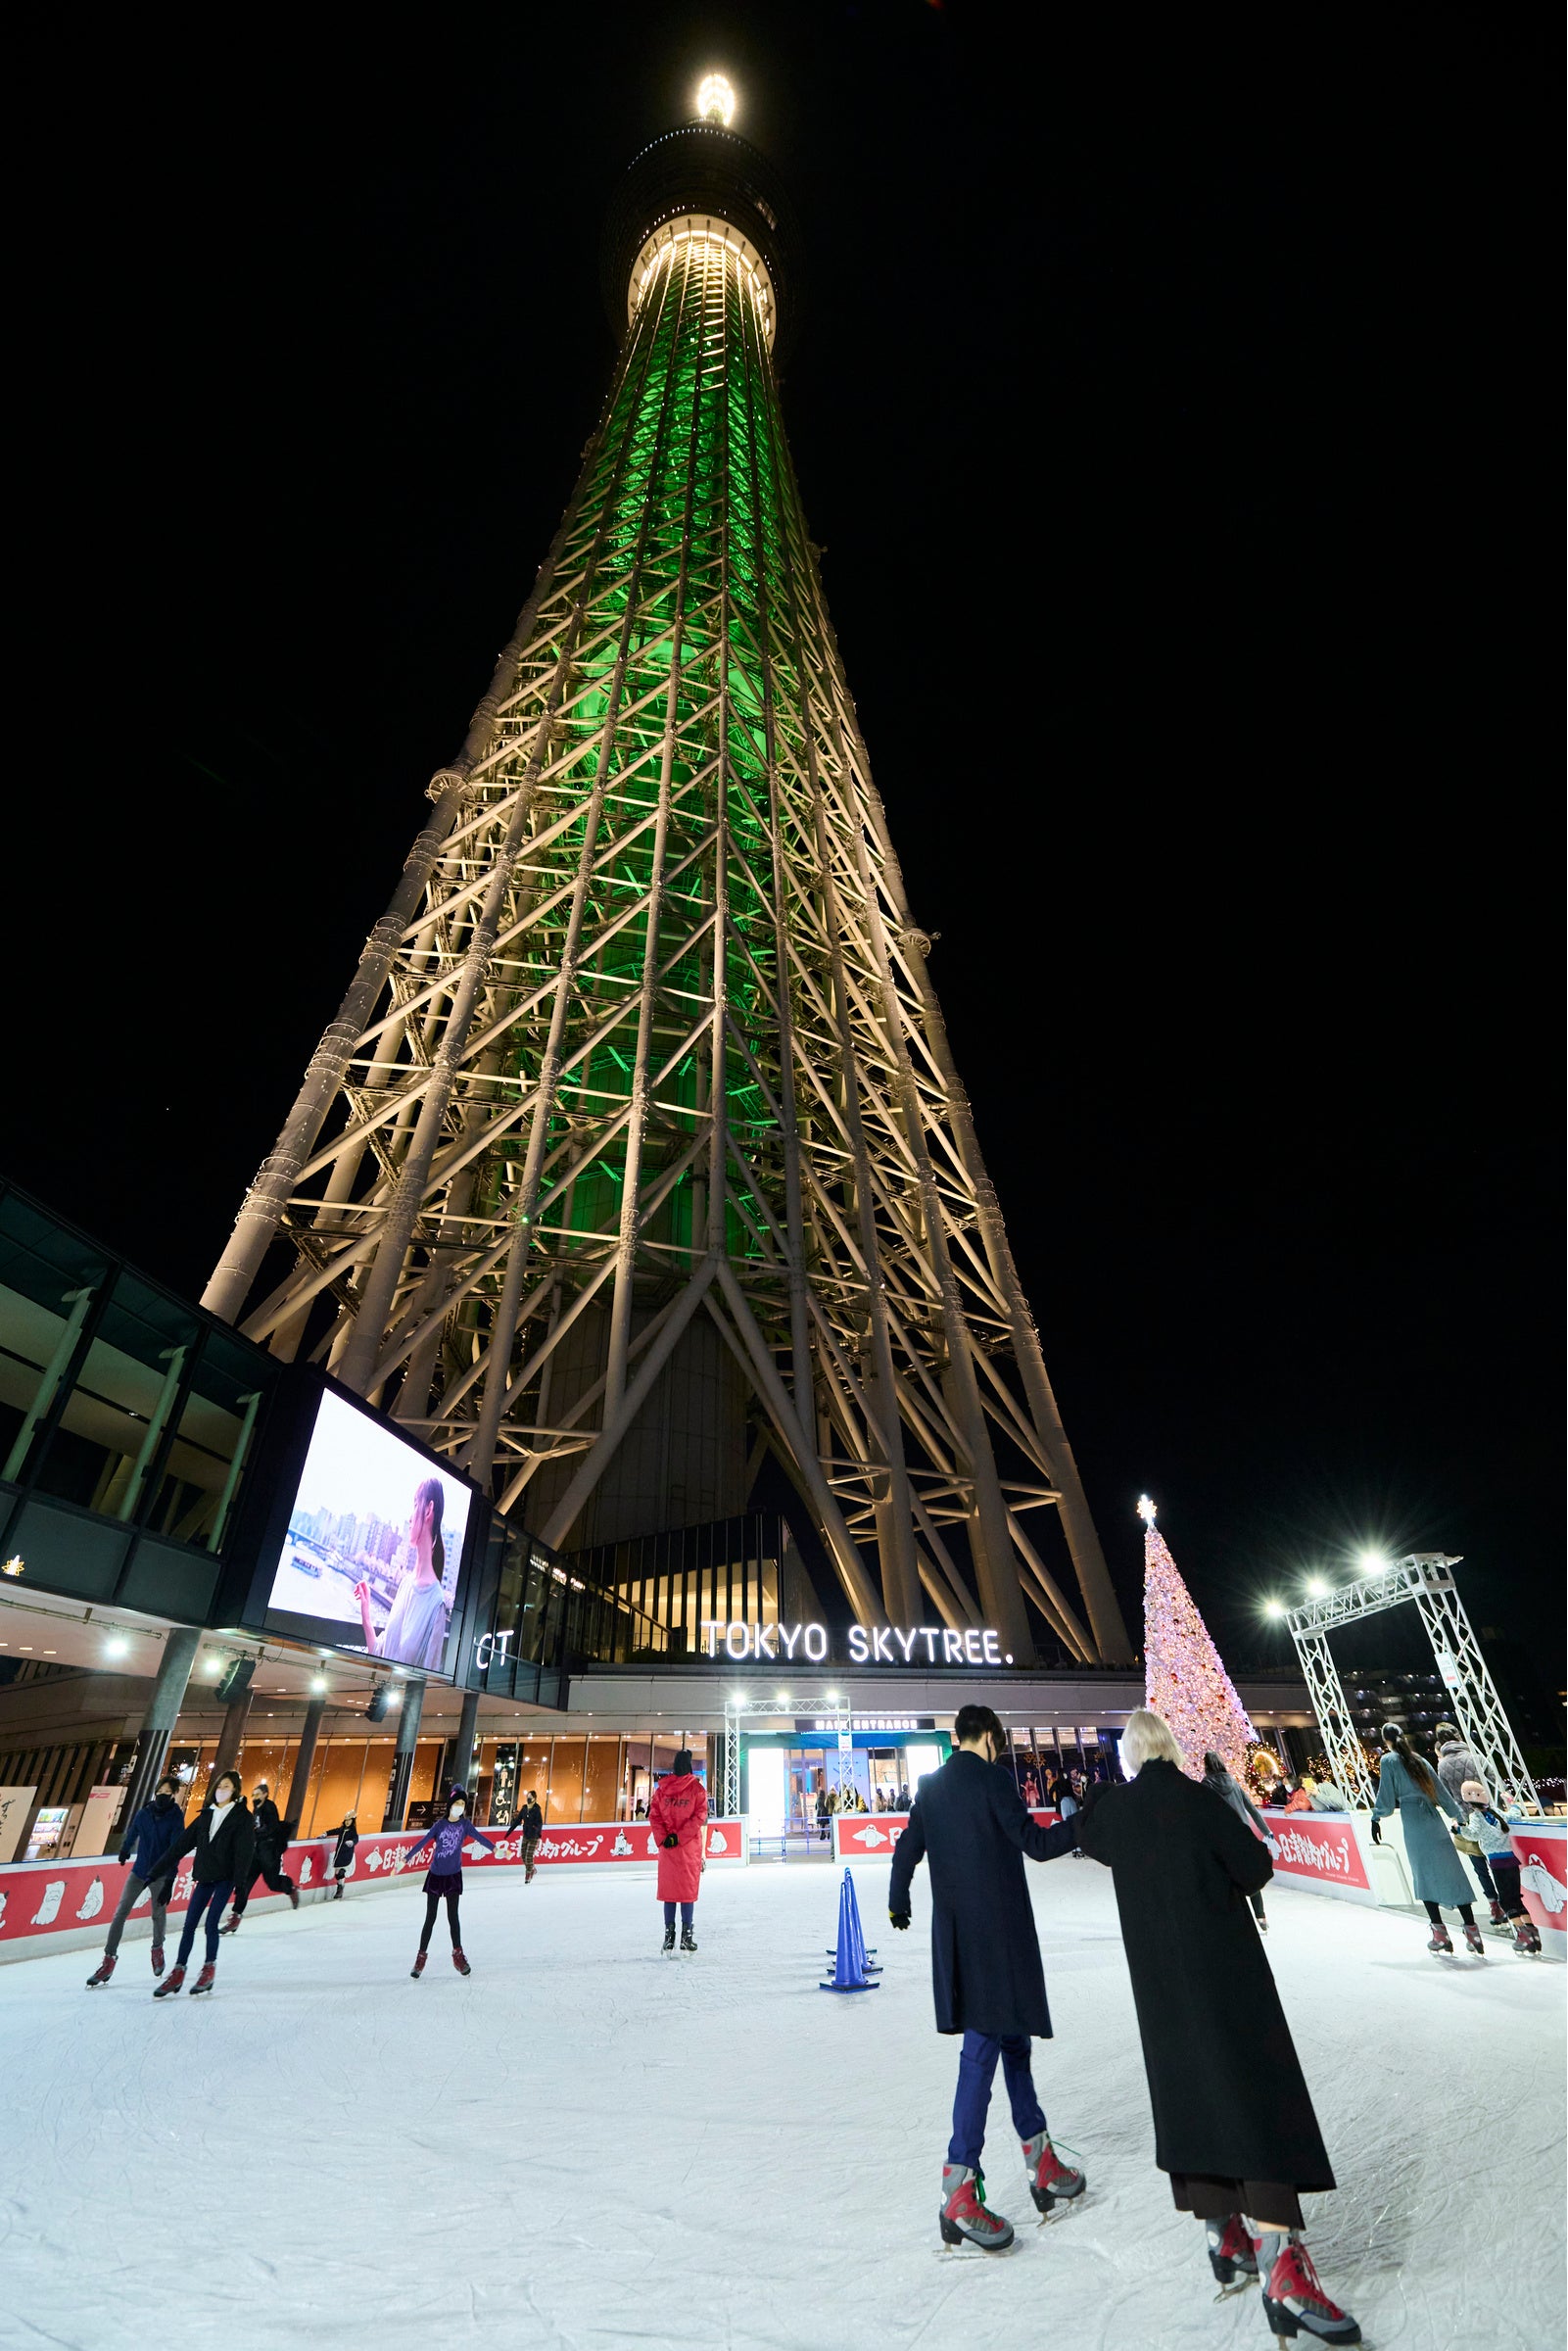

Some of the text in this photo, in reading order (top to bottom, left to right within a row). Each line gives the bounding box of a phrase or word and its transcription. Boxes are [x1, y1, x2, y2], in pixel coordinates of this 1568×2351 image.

[700, 1620, 1014, 1664] TOKYO SKYTREE.
[853, 1719, 919, 1730] ENTRANCE
[664, 1798, 689, 1807] STAFF
